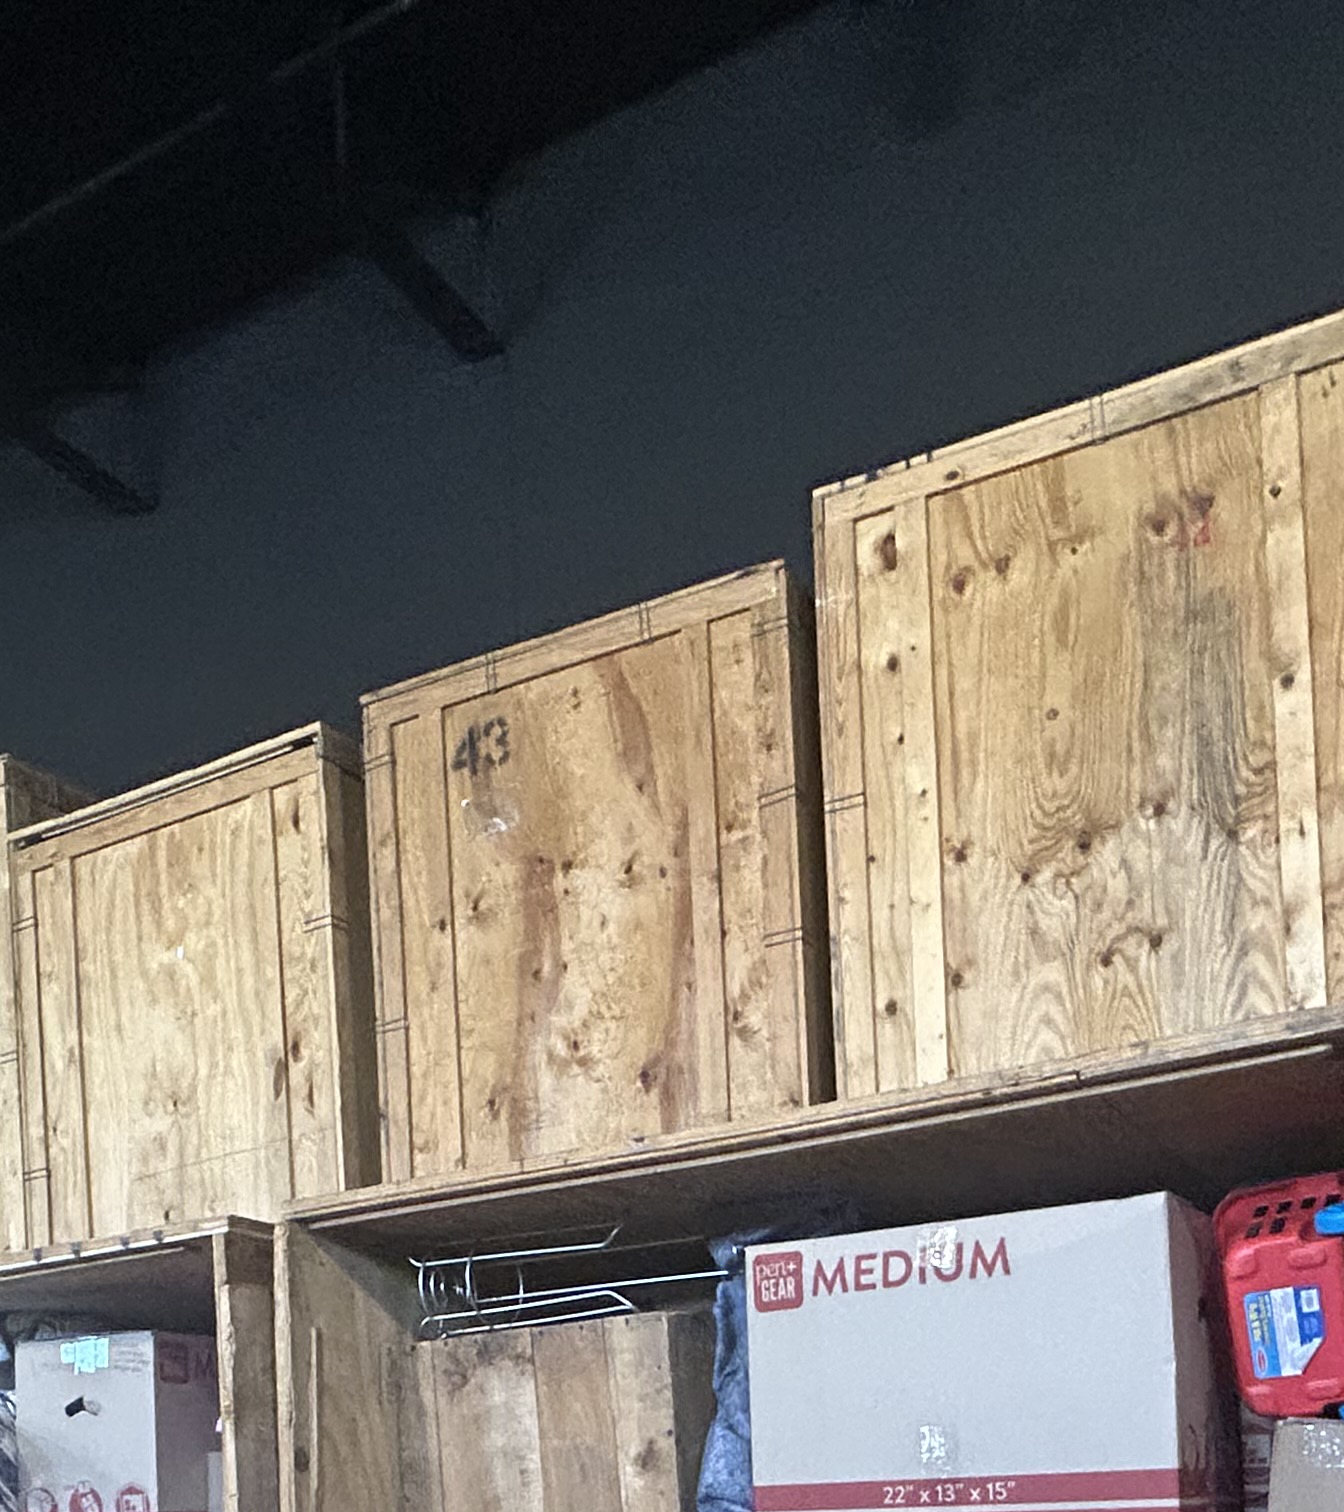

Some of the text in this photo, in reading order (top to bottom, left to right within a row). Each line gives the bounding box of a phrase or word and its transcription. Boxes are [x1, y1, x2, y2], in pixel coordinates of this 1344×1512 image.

[449, 716, 511, 777] 43
[811, 1236, 1011, 1297] MEDIUM
[760, 1276, 796, 1302] GEAR
[882, 1480, 1017, 1504] 22" x 13" x 15"
